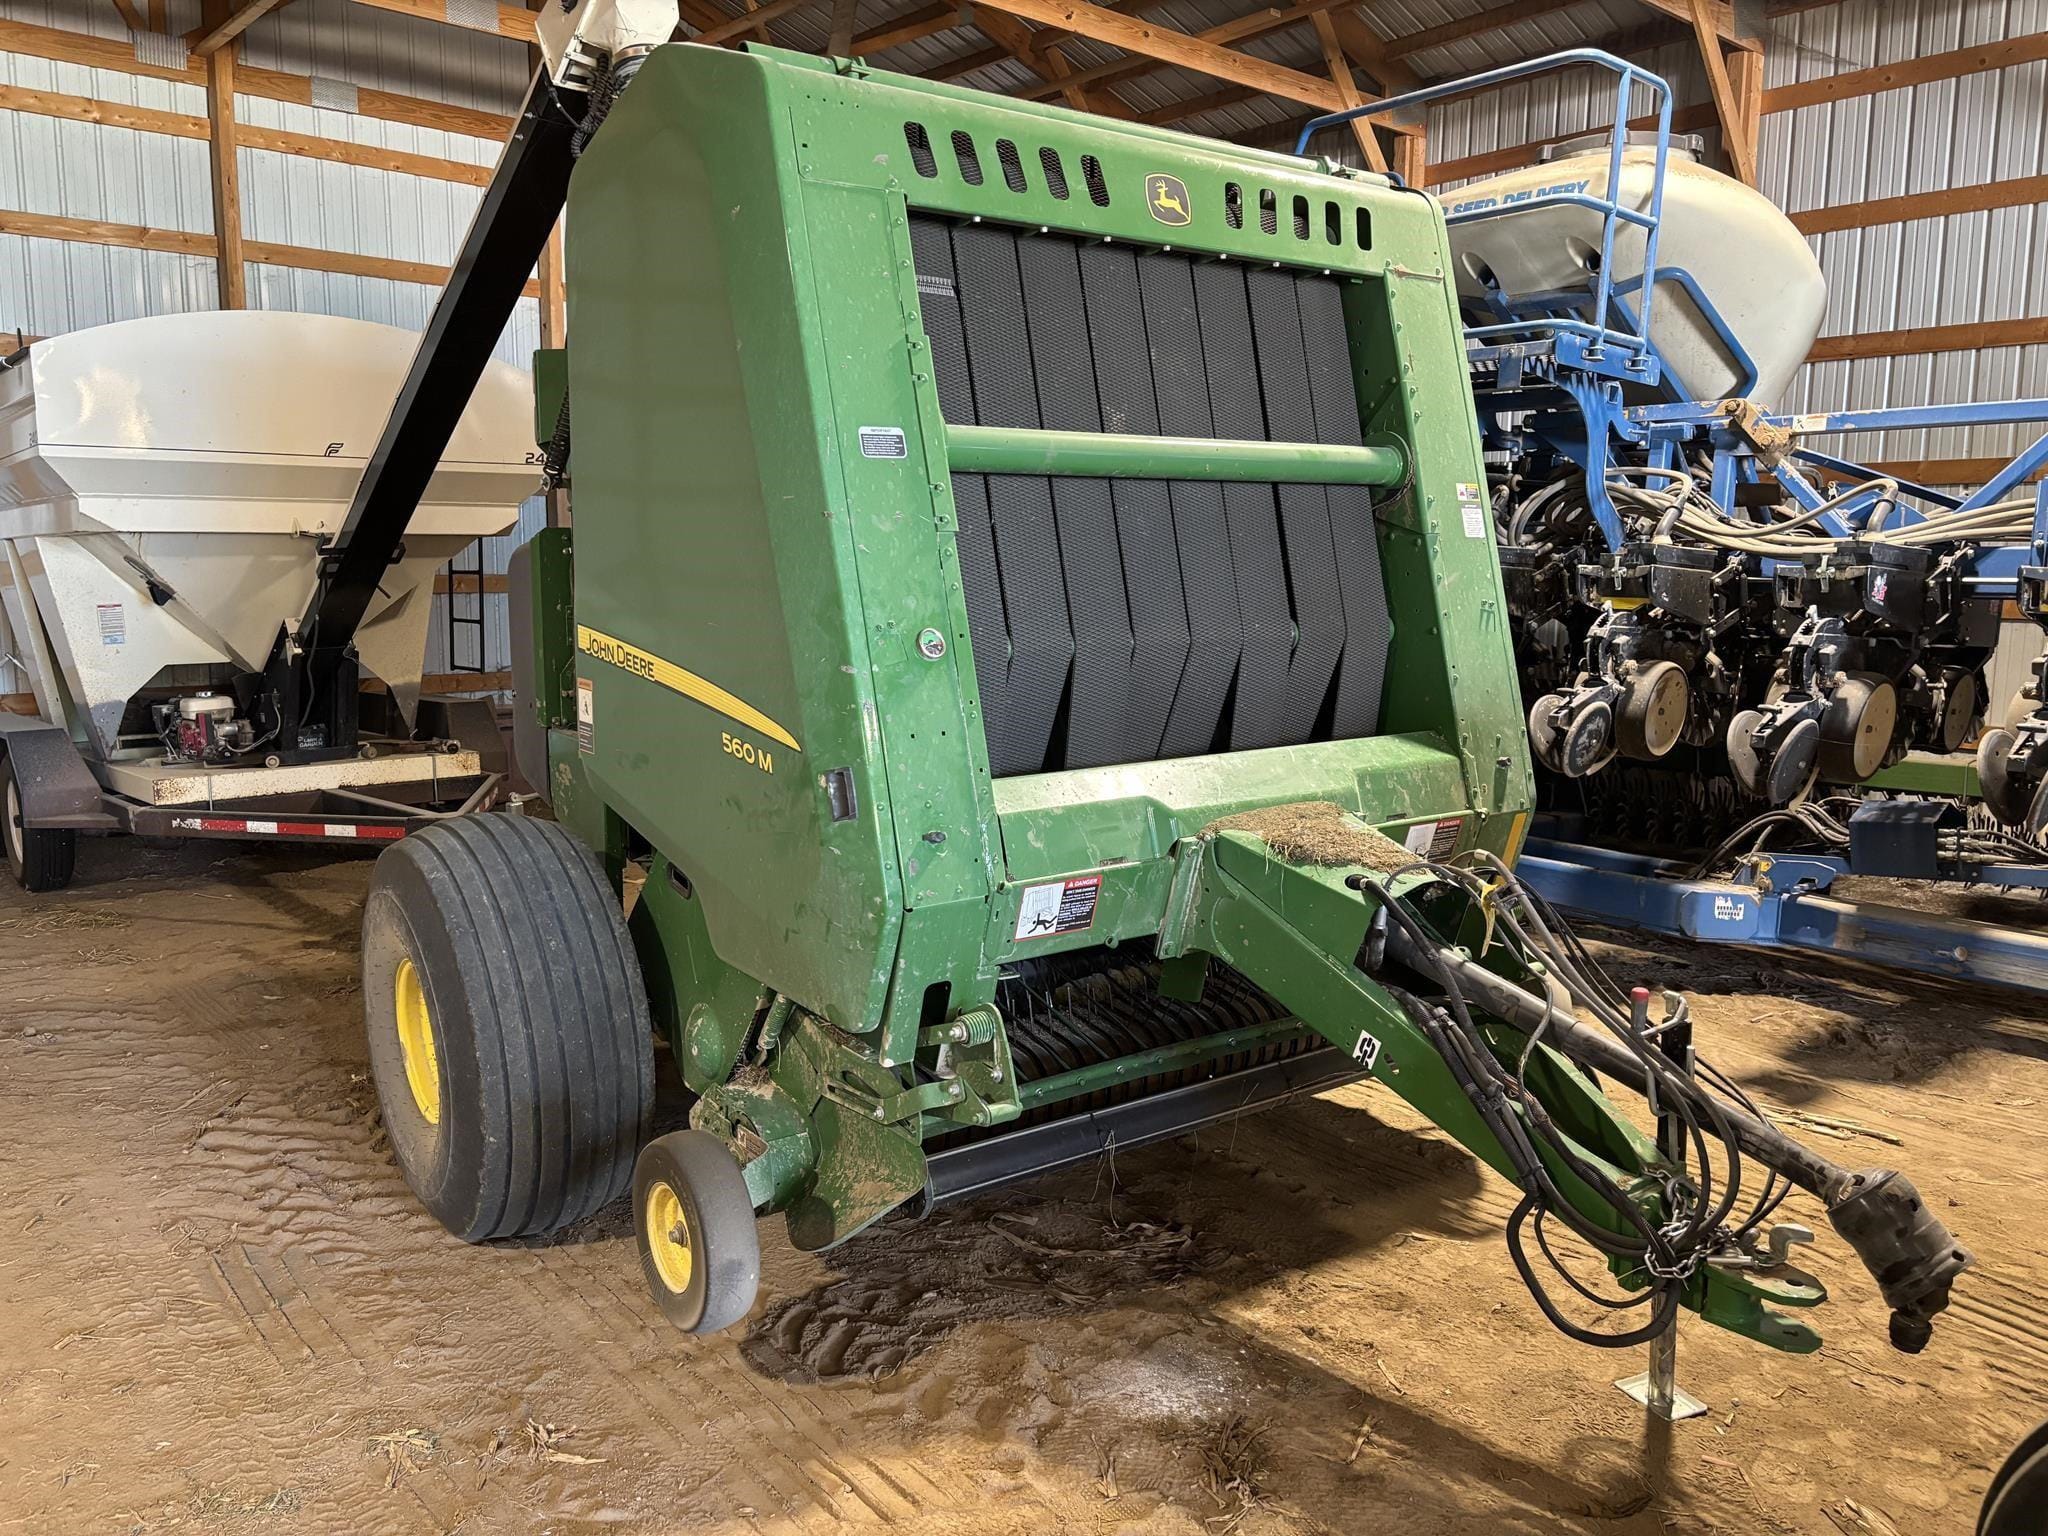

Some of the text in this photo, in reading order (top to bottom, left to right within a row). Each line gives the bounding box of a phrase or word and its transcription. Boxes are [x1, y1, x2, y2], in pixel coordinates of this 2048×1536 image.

[1454, 198, 1496, 214] SEED
[1503, 180, 1590, 204] DELIVERY
[585, 633, 656, 680] JOHN DEERE
[721, 731, 773, 774] 560 M
[1074, 878, 1098, 887] DANGER
